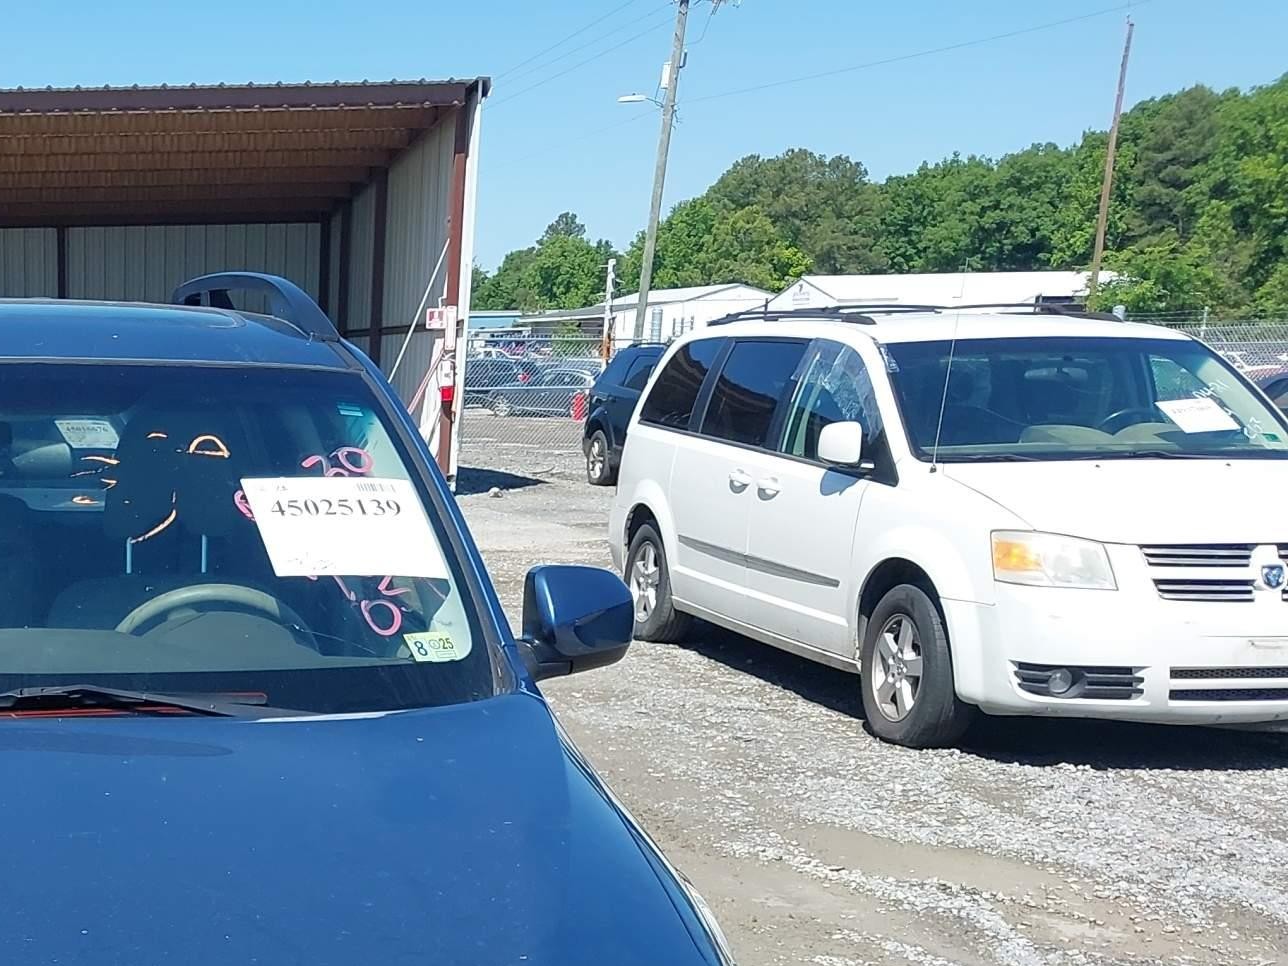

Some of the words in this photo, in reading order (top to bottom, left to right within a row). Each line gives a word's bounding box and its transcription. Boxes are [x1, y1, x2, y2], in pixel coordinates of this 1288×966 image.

[271, 499, 402, 516] 45025139
[414, 640, 428, 656] 8
[439, 638, 454, 650] 25
